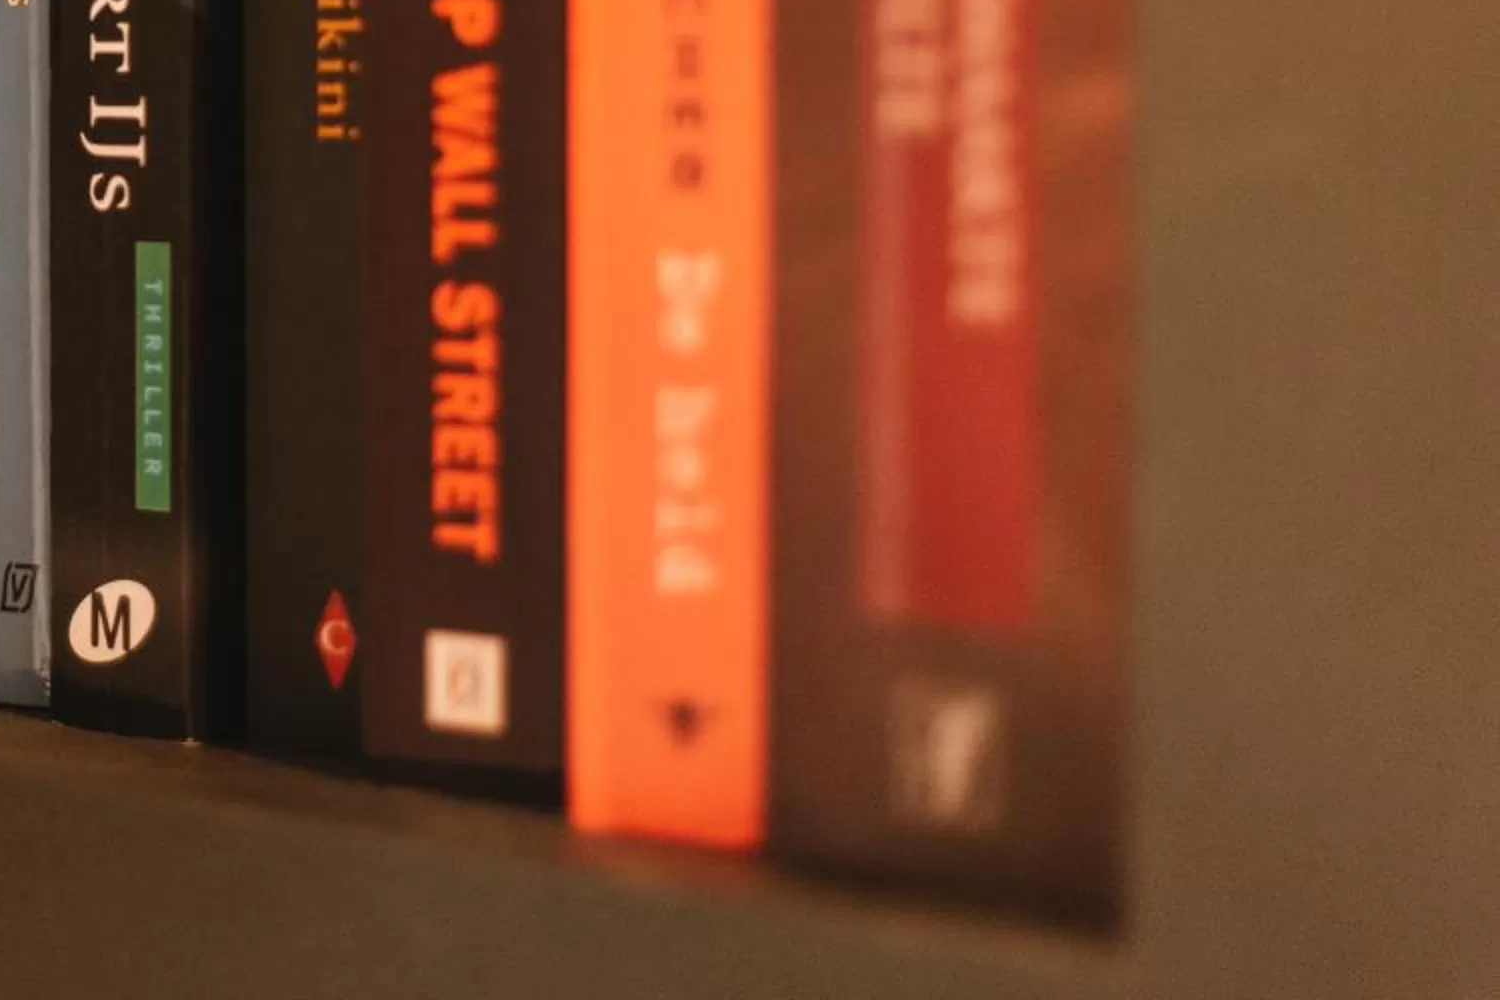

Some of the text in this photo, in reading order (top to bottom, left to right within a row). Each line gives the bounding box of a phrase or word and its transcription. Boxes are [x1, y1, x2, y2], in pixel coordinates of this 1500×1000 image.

[428, 63, 500, 263] WALL
[140, 278, 164, 479] THRILLER
[428, 280, 500, 562] STREET
[90, 591, 133, 652] M
